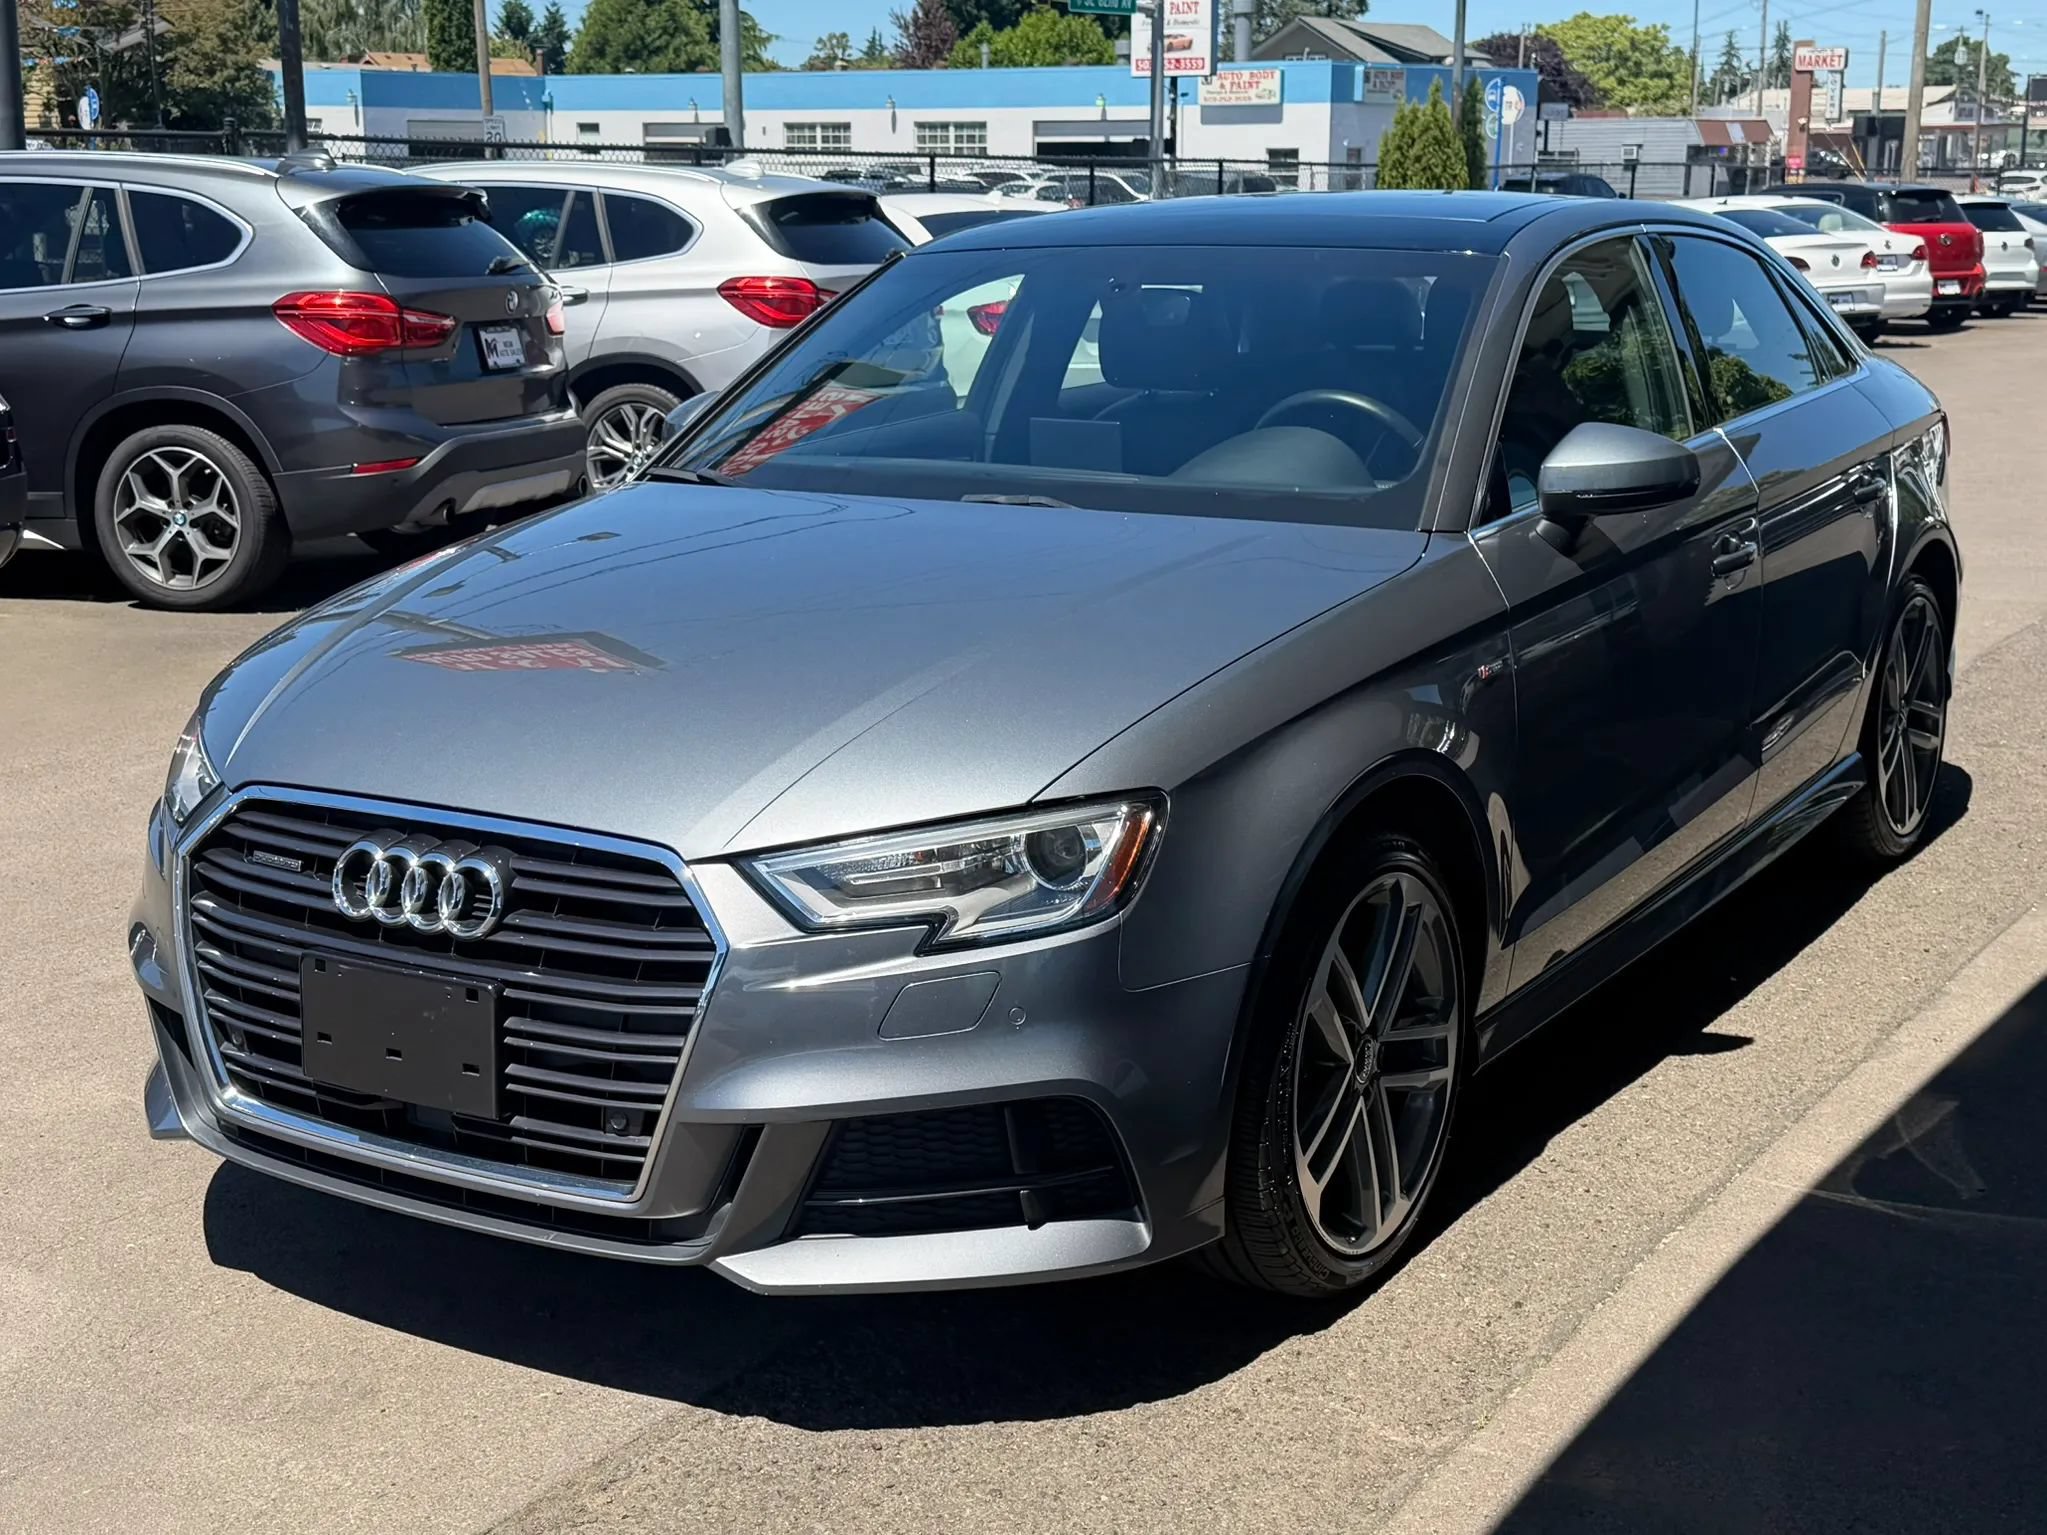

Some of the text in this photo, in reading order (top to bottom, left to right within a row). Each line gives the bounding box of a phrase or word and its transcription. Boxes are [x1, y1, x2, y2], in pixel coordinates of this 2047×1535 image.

[1170, 2, 1200, 14] PAINT
[1798, 55, 1843, 68] MARKET
[1217, 71, 1276, 80] AUTO BODY
[1230, 81, 1261, 89] PAINT
[486, 131, 502, 143] 20
